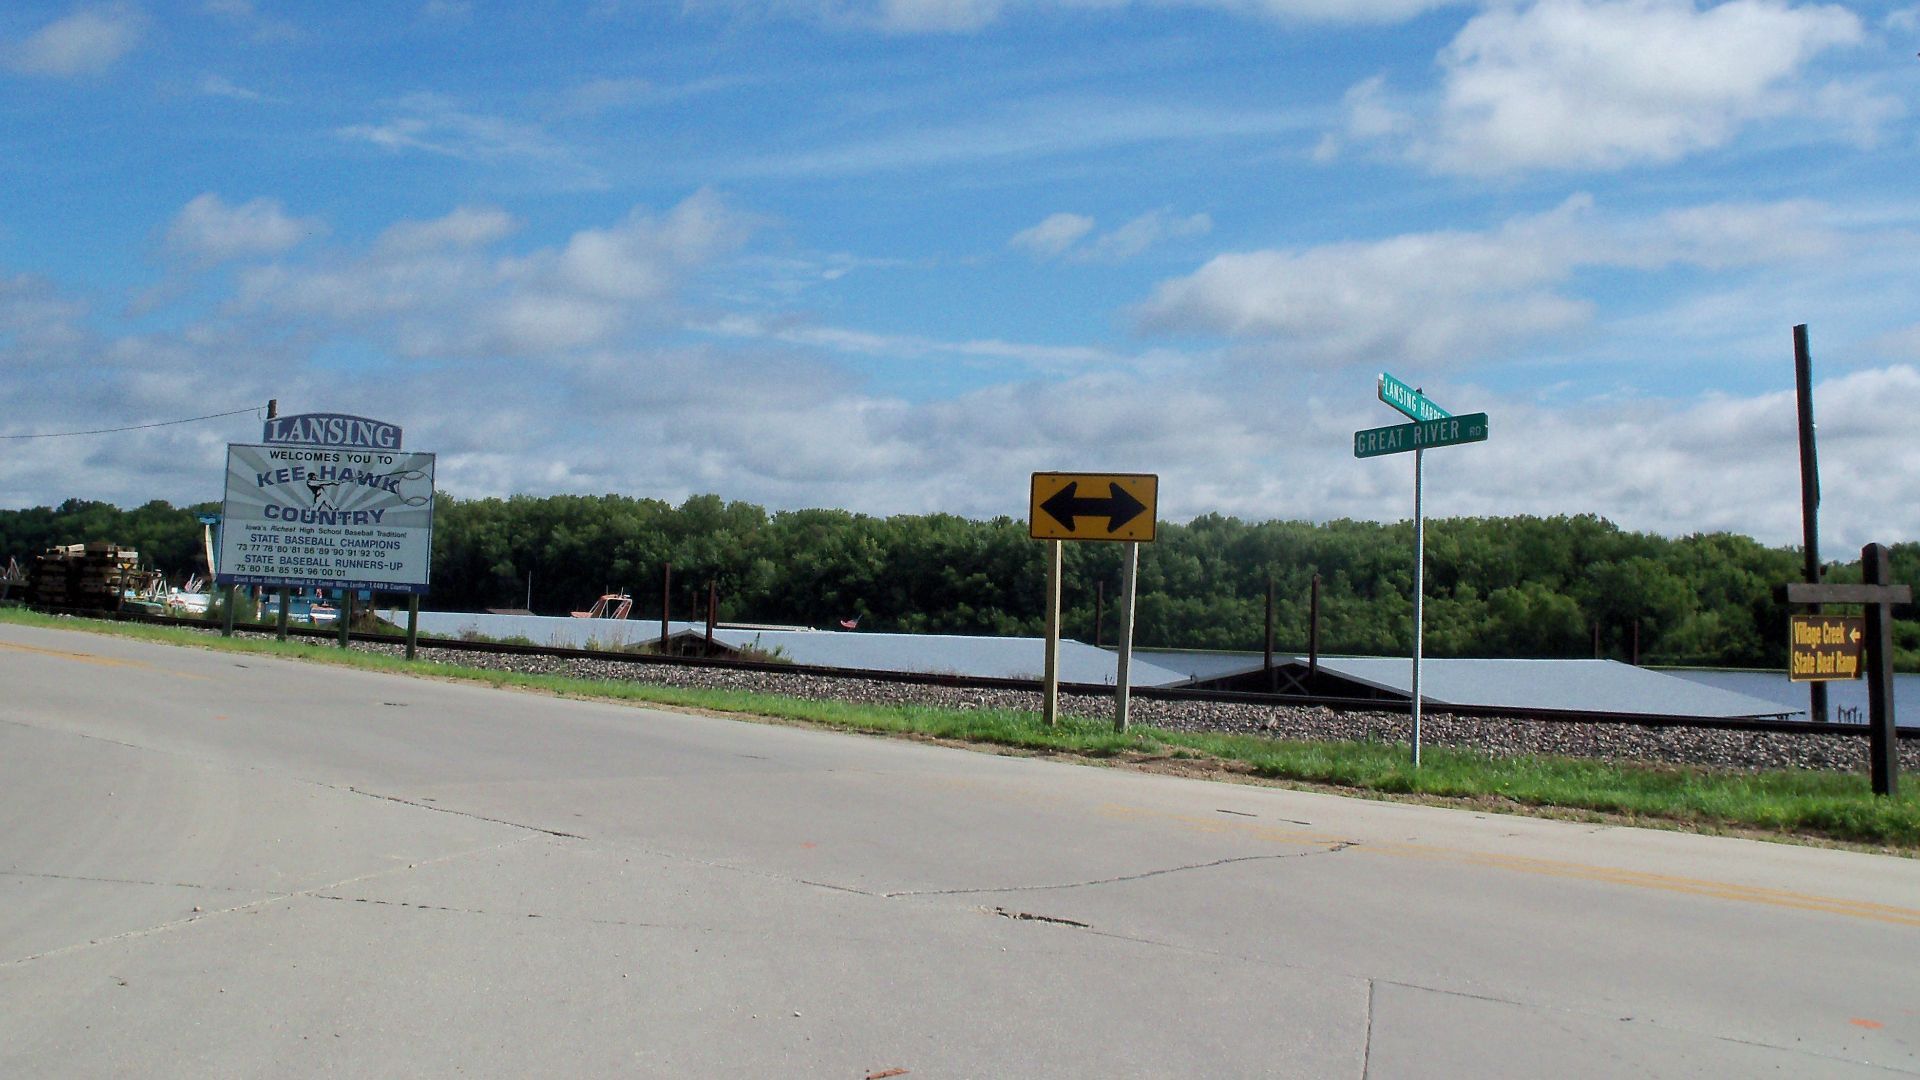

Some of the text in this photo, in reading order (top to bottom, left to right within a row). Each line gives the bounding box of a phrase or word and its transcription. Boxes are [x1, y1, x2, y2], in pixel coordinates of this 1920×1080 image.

[1385, 378, 1417, 412] LANSING
[269, 417, 395, 448] LANSING
[1358, 420, 1482, 453] GREAT RIVER RD
[270, 450, 393, 465] WELCOMES YOU TO
[256, 465, 399, 494] KEE HAWK
[245, 524, 267, 532] Iowa's
[300, 526, 315, 534] High
[264, 504, 386, 526] COUNTRY
[250, 534, 400, 550] STATE BASEBALL CHAMPIONS
[245, 554, 404, 571] STATE BASEBALL RUNNERS-UP
[1794, 621, 1845, 649] Village Creek
[1794, 650, 1858, 678] State Boat Ramp
